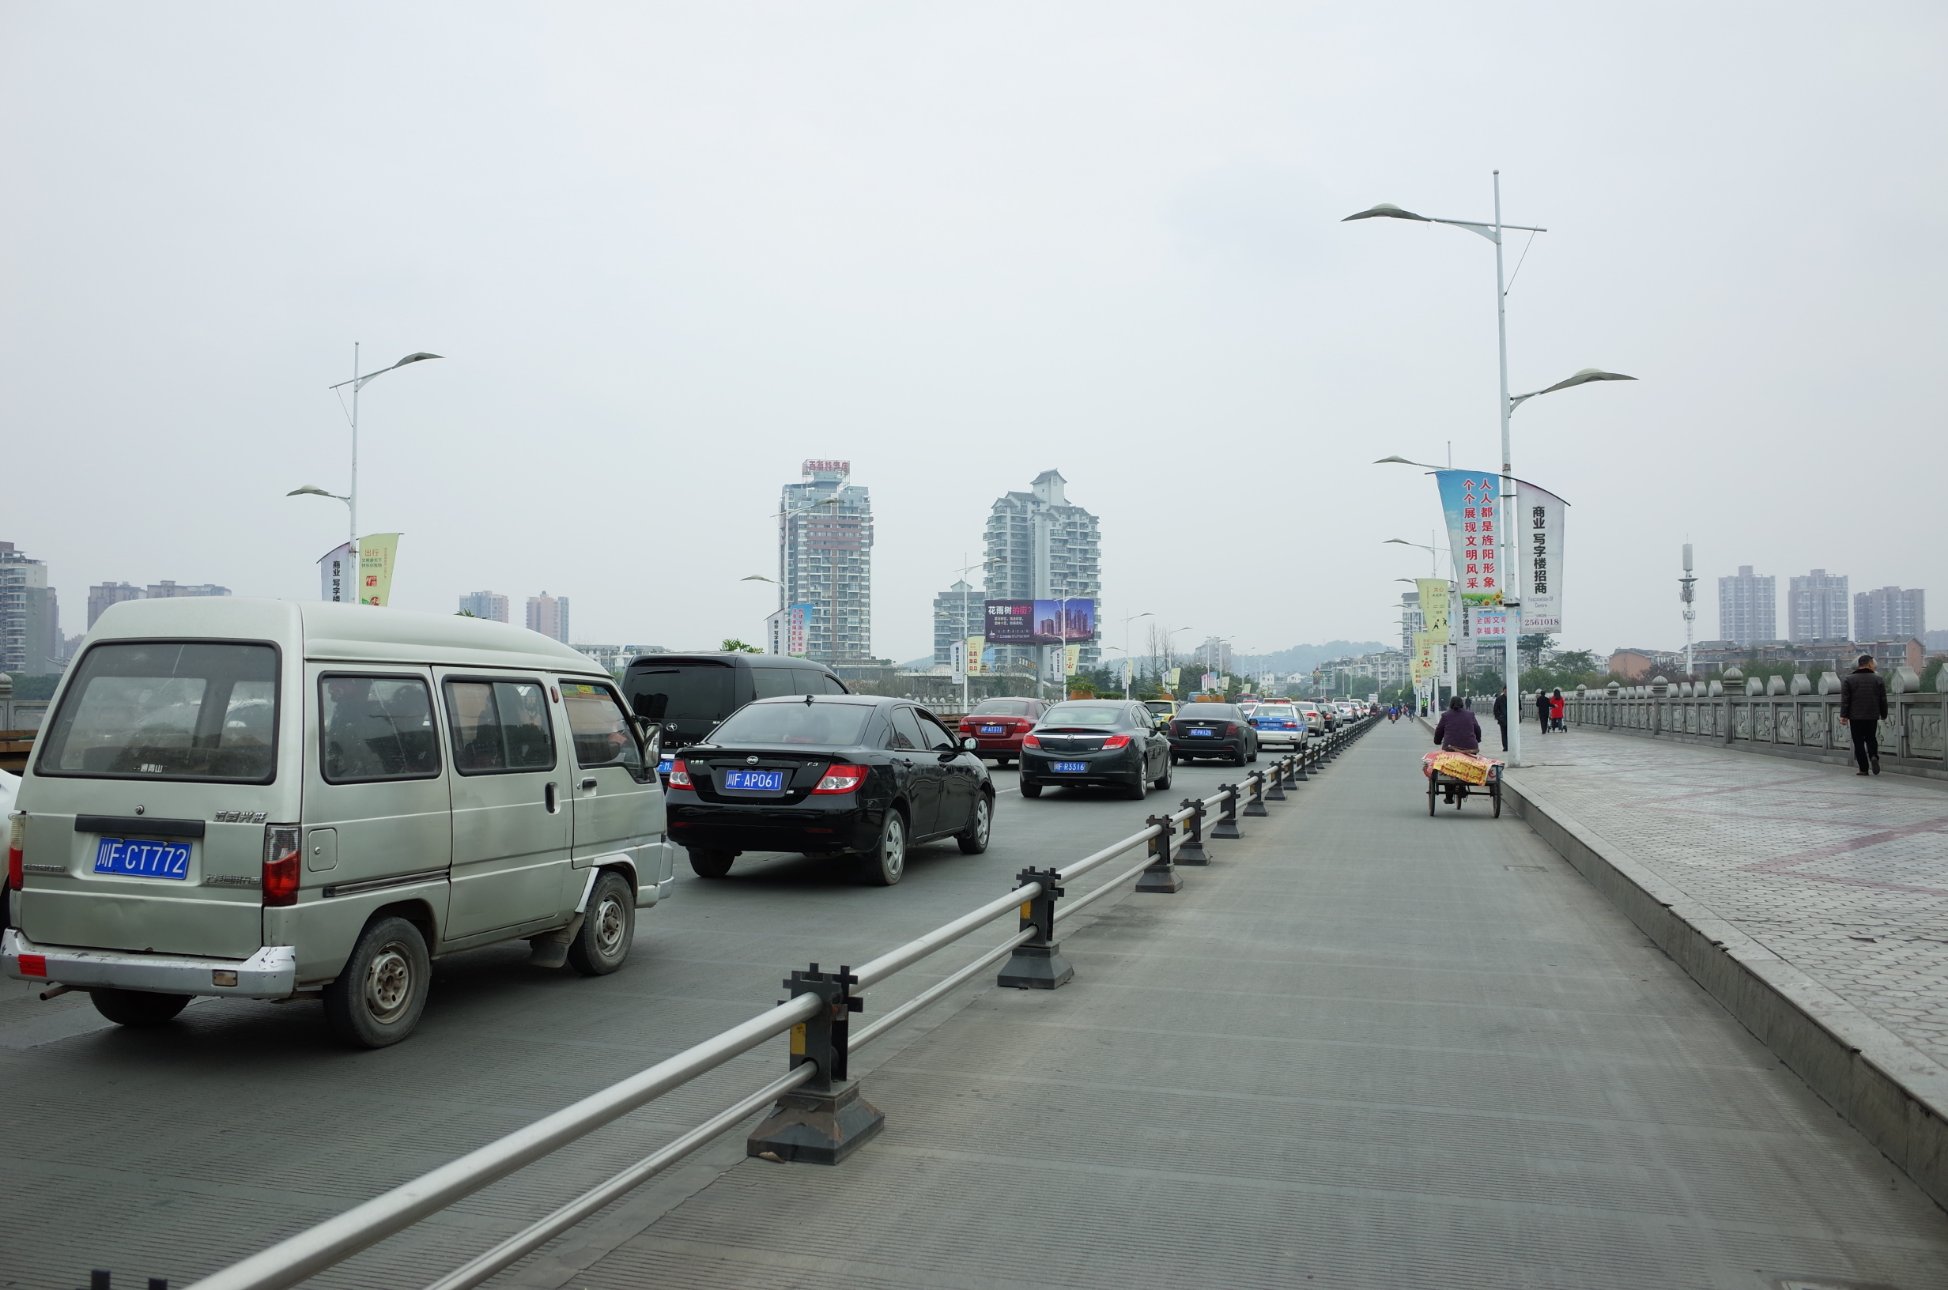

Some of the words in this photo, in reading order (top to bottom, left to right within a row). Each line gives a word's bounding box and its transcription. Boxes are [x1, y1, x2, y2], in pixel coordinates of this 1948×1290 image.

[1463, 479, 1479, 589] 个个展现文明风采
[1480, 479, 1495, 589] 人人都是旌阳形象
[1532, 506, 1546, 530] 商业
[1533, 533, 1547, 594] 写字楼招商
[1525, 618, 1559, 626] 2561018
